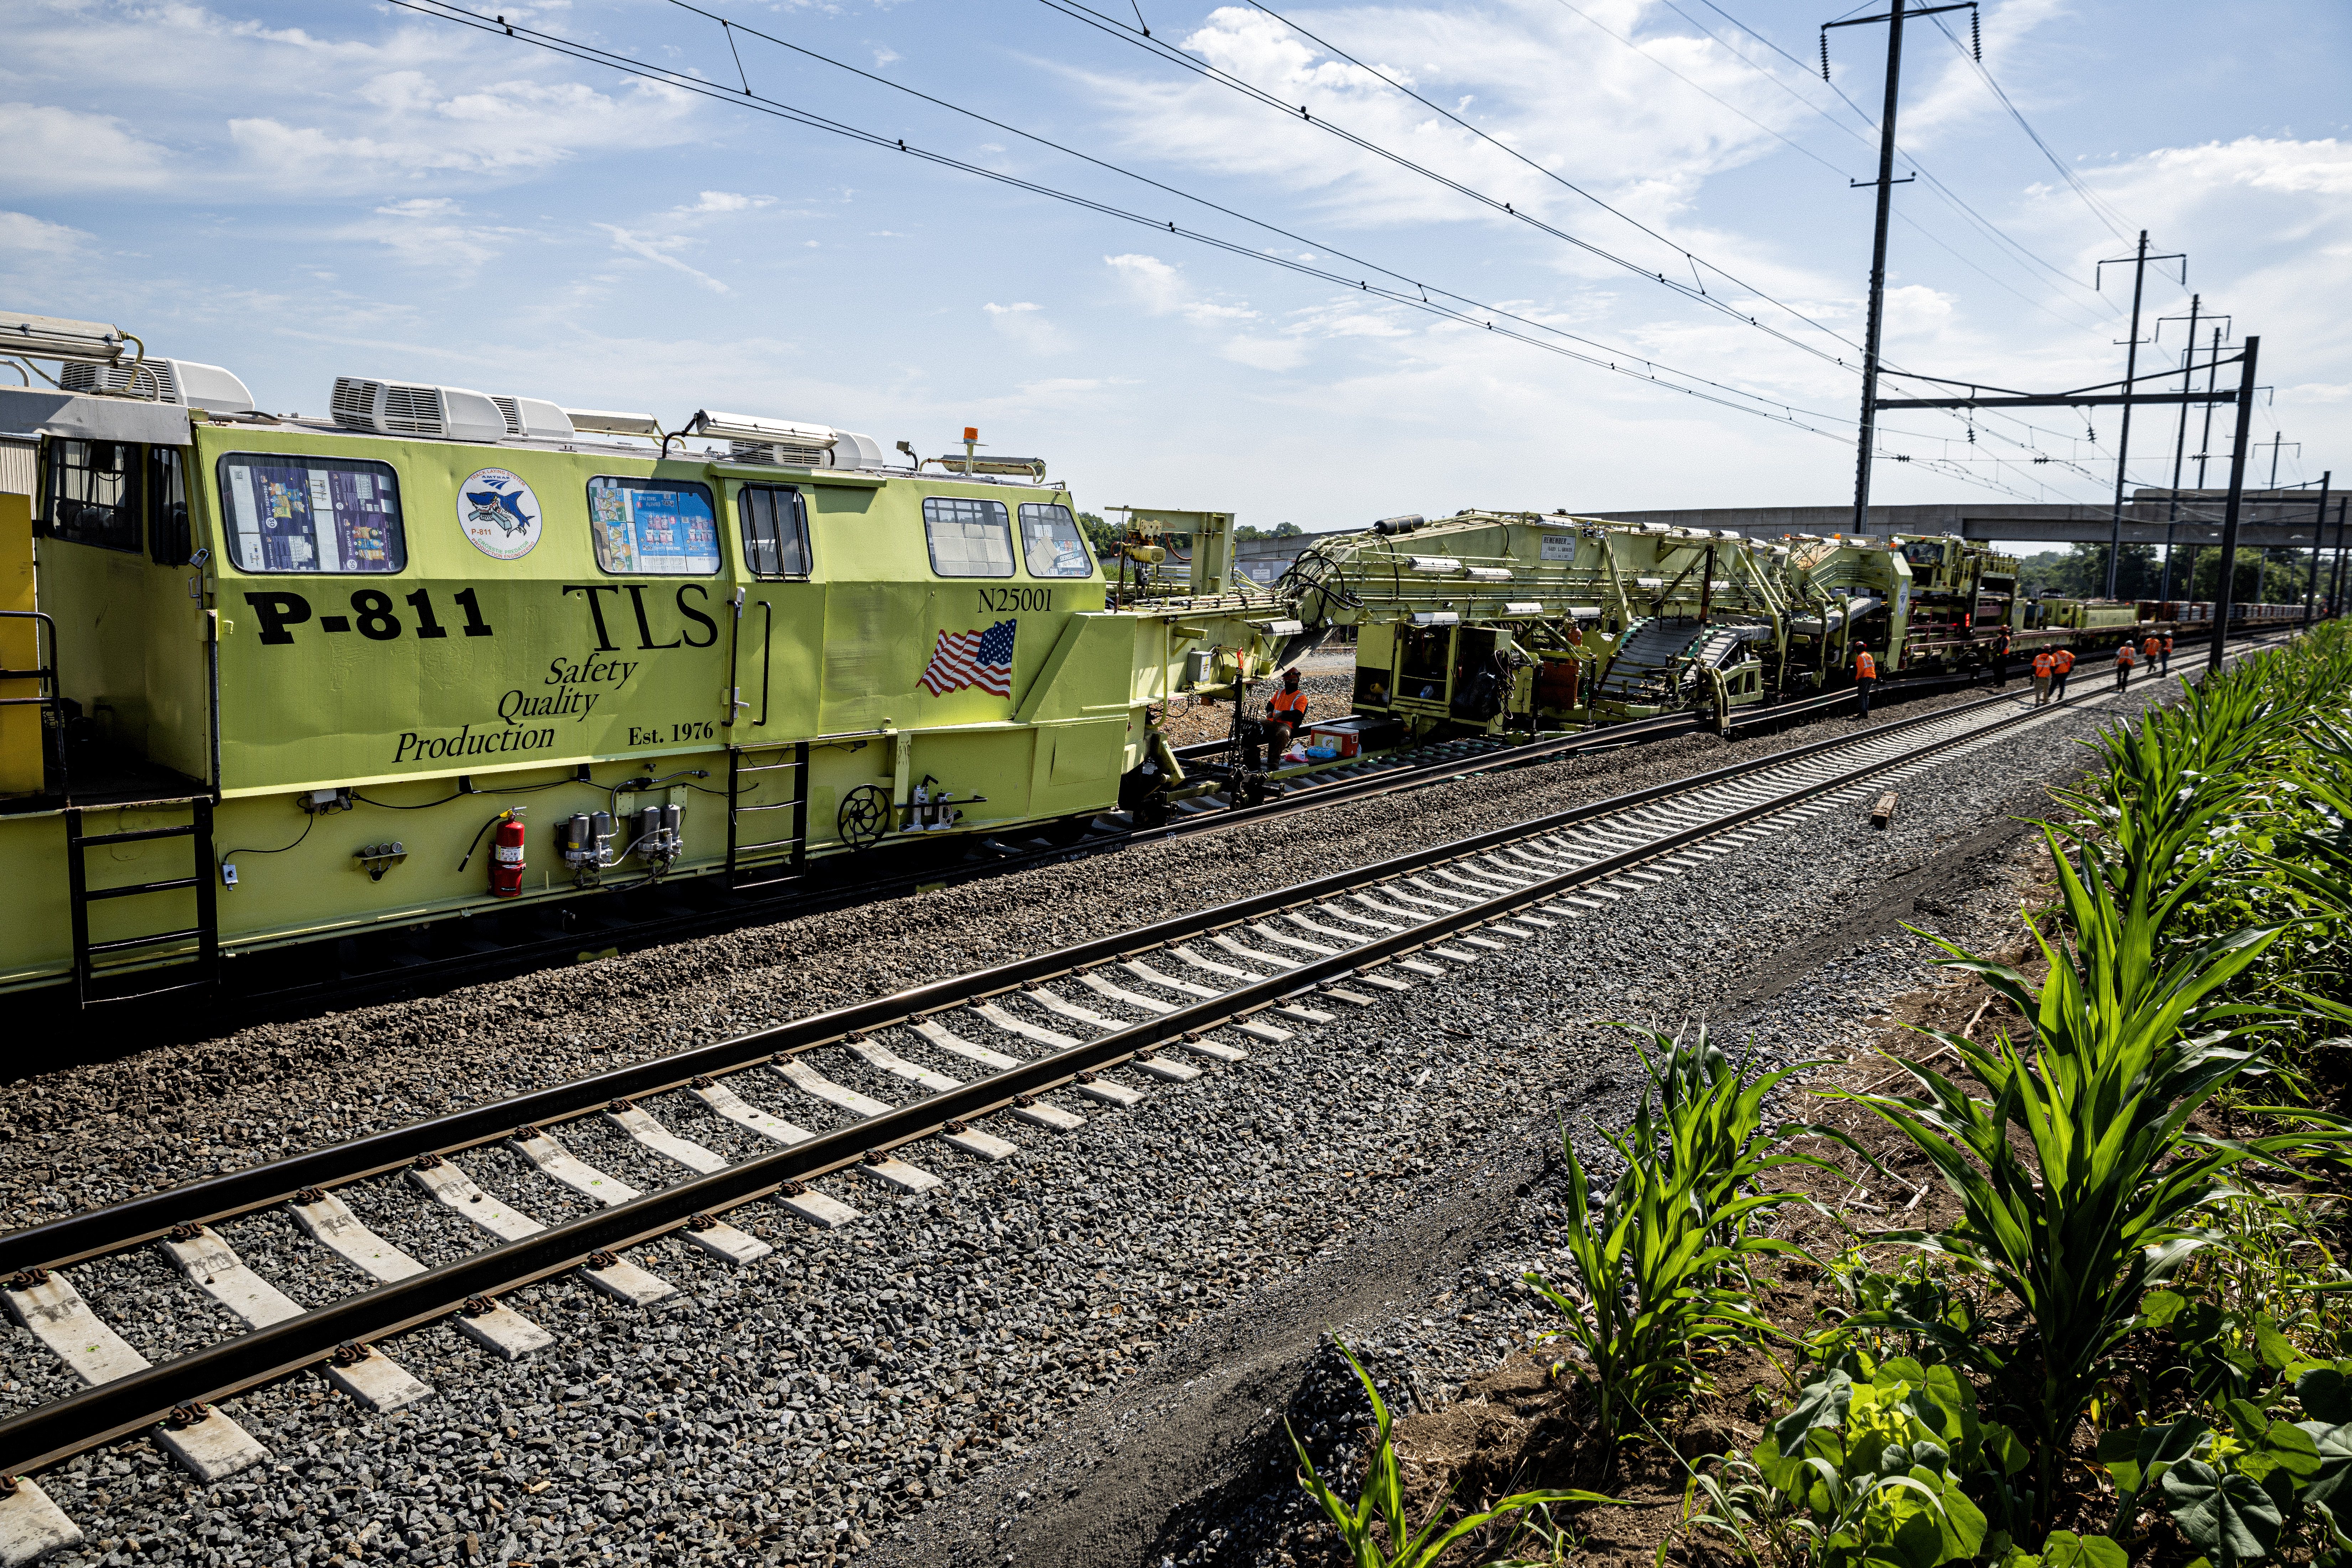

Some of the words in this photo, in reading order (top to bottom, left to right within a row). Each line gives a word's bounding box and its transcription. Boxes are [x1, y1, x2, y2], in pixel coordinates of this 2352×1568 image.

[470, 470, 486, 481] TRACK
[507, 470, 525, 486] SYSTEM
[471, 538, 502, 558] PRODUCTION
[478, 538, 503, 554] CROSSTIE
[505, 541, 530, 554] PREDATOR
[1543, 536, 1567, 545] REMEMBER
[978, 588, 1052, 613] N25001
[243, 588, 493, 645] P-811
[563, 584, 718, 651] TLS
[545, 653, 639, 690] Safety
[498, 685, 600, 726] Quality
[392, 724, 555, 763] Production
[628, 727, 664, 746] Est.
[671, 721, 713, 742] 1976
[1322, 736, 1334, 749] G
